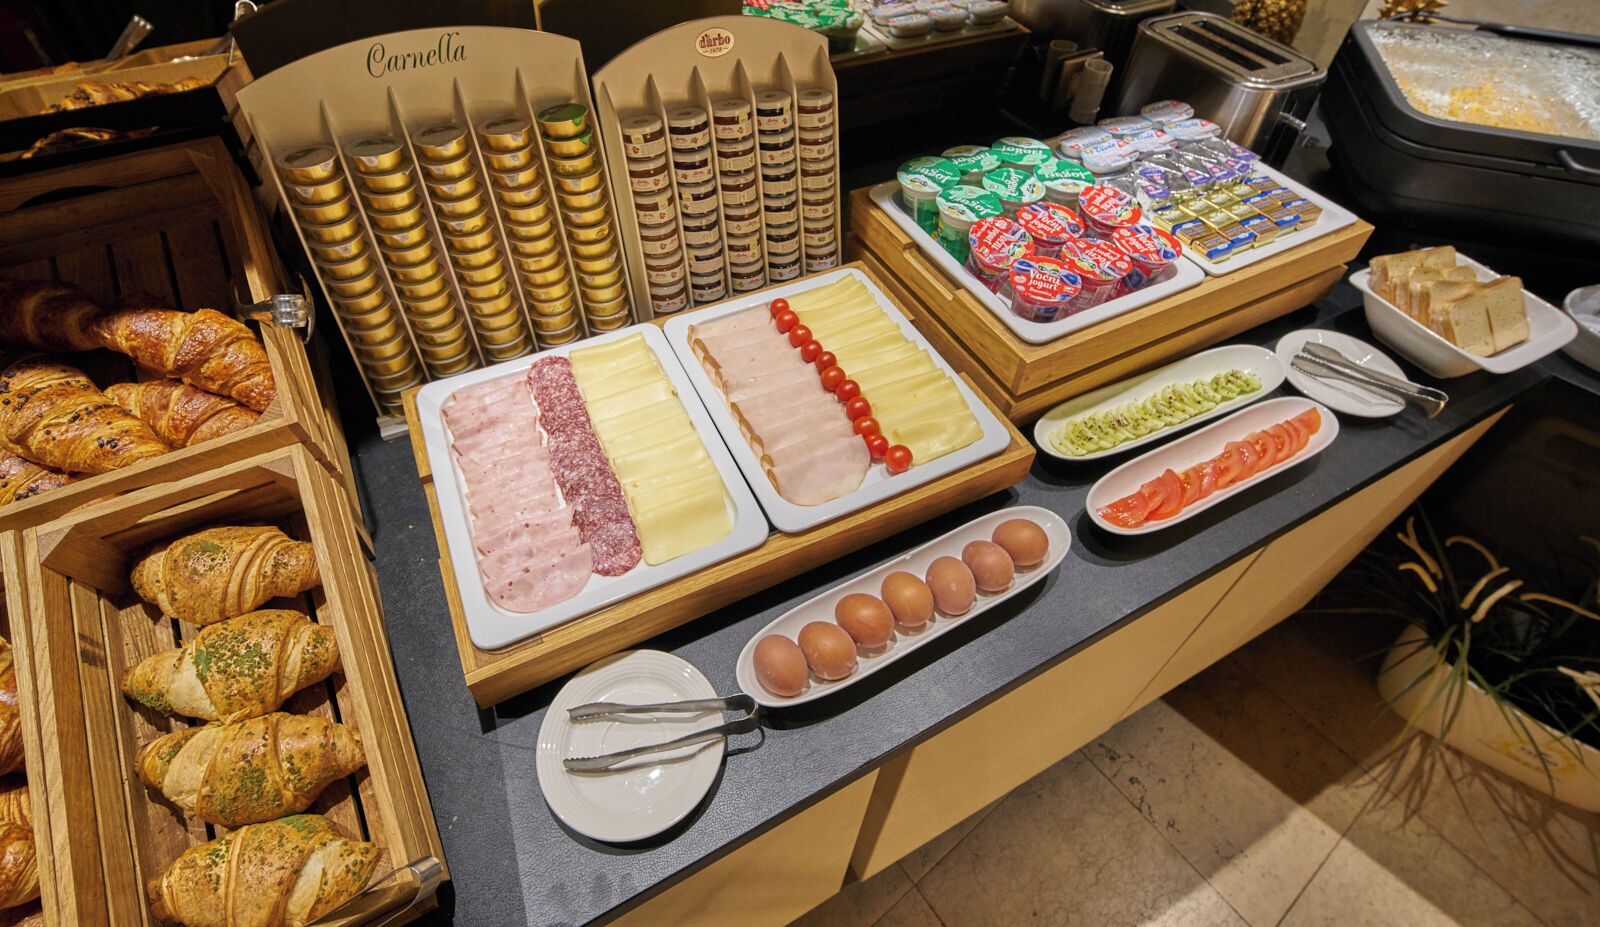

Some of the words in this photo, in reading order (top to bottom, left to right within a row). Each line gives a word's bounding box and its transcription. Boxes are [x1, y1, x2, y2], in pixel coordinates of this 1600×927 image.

[367, 32, 467, 78] Carnella
[1001, 146, 1043, 156] Jogurt
[910, 165, 952, 184] Jogurt
[1044, 172, 1091, 181] Jogurt
[951, 194, 990, 215] Jogurt
[1030, 217, 1055, 233] jogurt
[1090, 246, 1117, 261] jogurt
[1028, 279, 1059, 291] jogurt
[1029, 270, 1061, 285] Voćni
